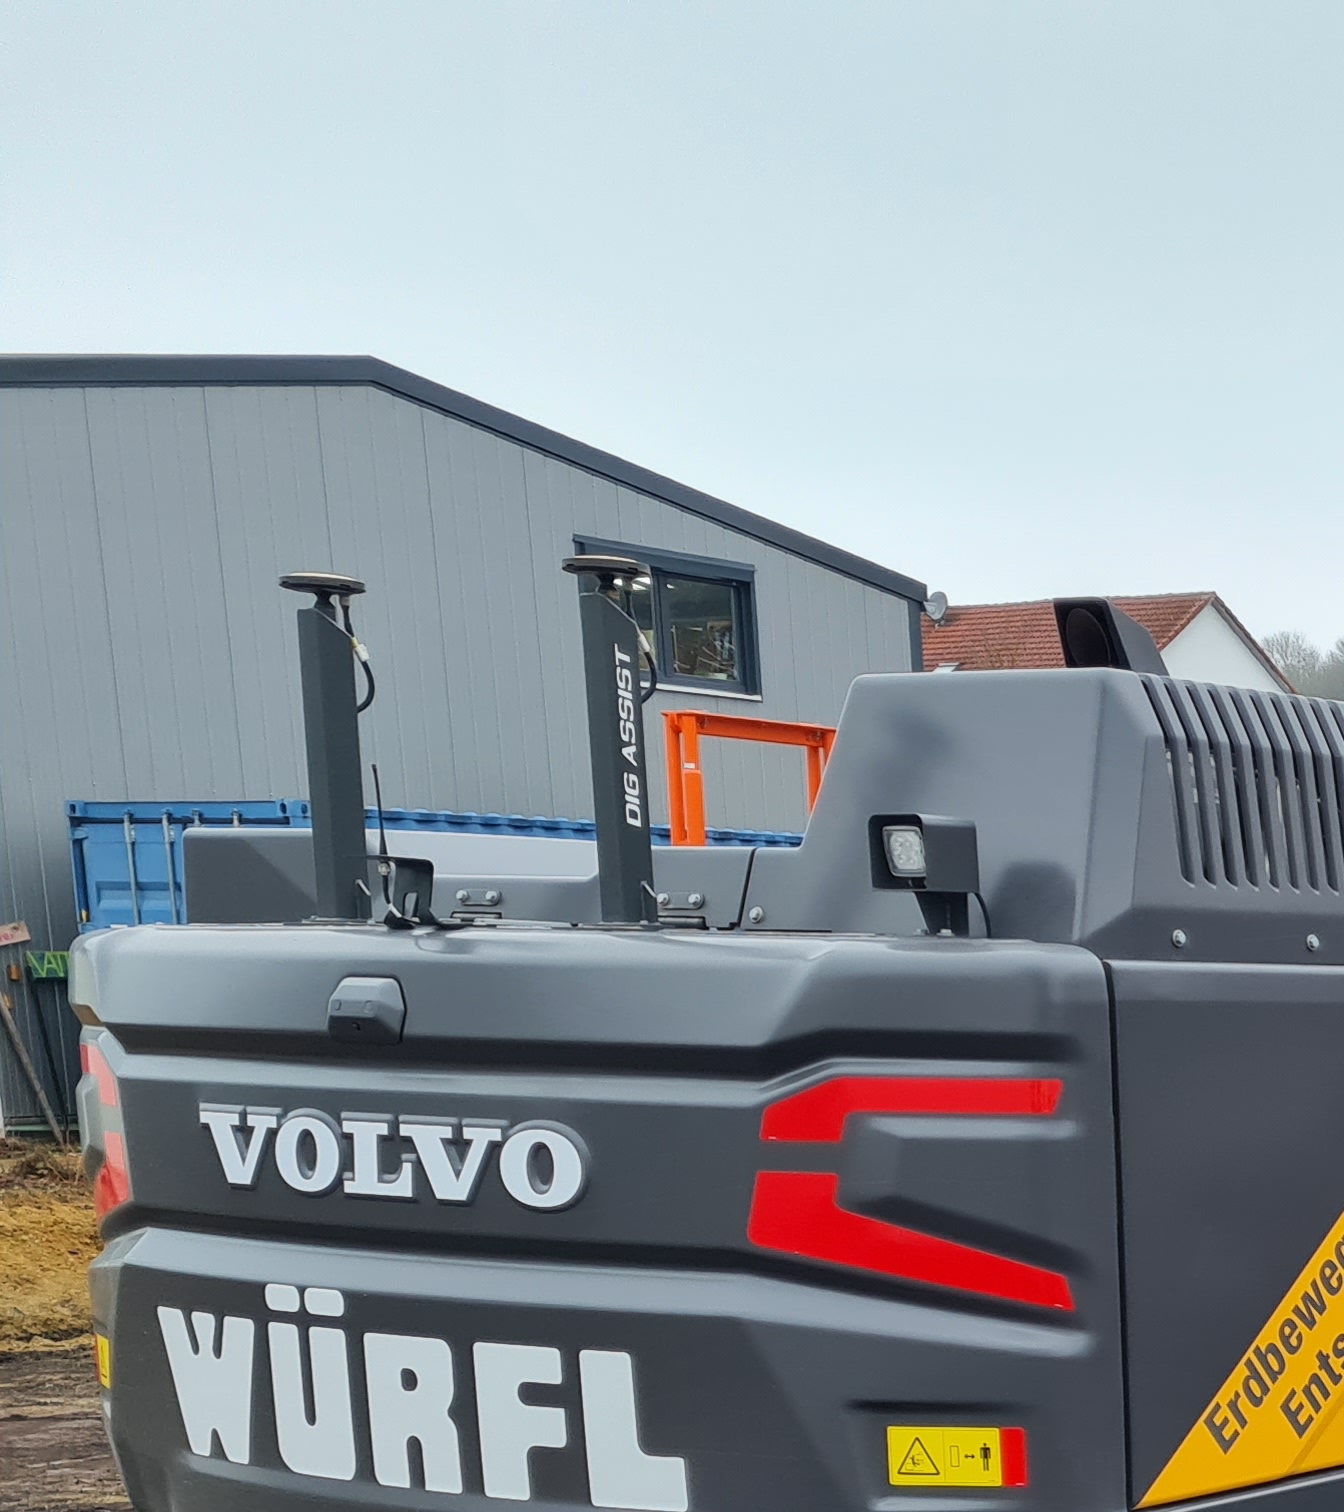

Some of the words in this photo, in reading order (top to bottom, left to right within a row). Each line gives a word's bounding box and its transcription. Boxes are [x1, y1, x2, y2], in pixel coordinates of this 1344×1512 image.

[614, 643, 638, 767] ASSIST
[623, 771, 642, 828] DIG
[200, 1104, 586, 1208] VOLVO
[157, 1283, 688, 1512] WÜRFL
